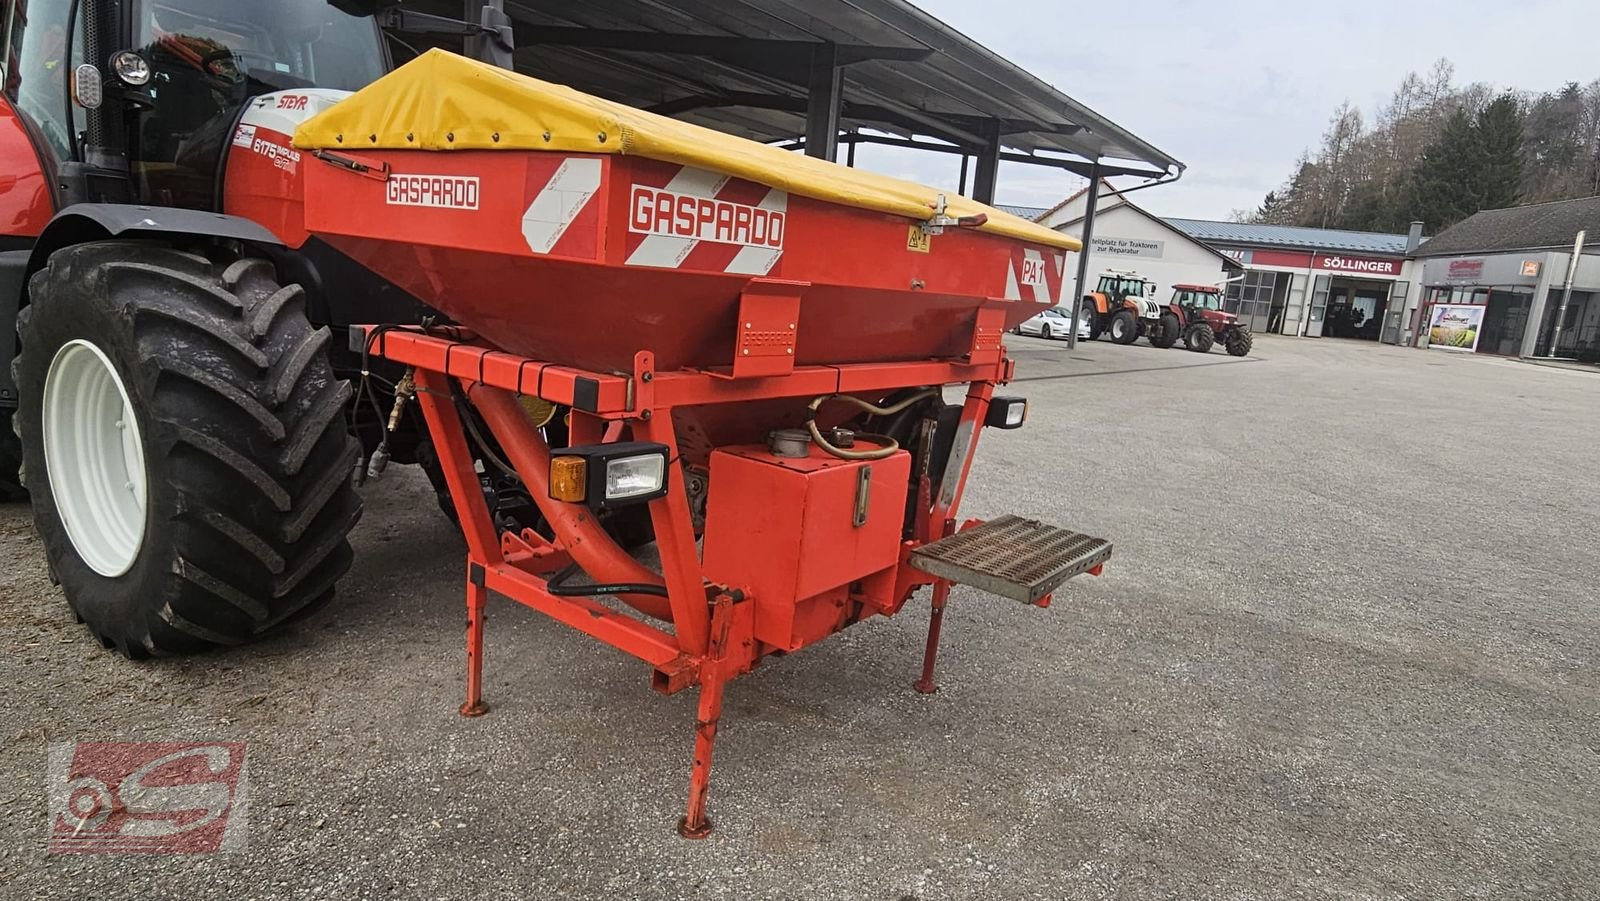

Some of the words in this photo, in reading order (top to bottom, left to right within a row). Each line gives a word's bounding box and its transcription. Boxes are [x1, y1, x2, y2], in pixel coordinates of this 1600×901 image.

[277, 94, 308, 110] STEYR
[253, 138, 277, 159] 6175
[388, 176, 477, 208] GASPARDO
[631, 188, 783, 247] GASPARDO
[1092, 238, 1117, 247] tellplatz
[1129, 241, 1158, 249] Traktoren
[1108, 246, 1140, 255] Reparatur
[1023, 260, 1036, 283] PA
[1038, 263, 1044, 284] 1
[1323, 256, 1393, 273] SÖLLINGER
